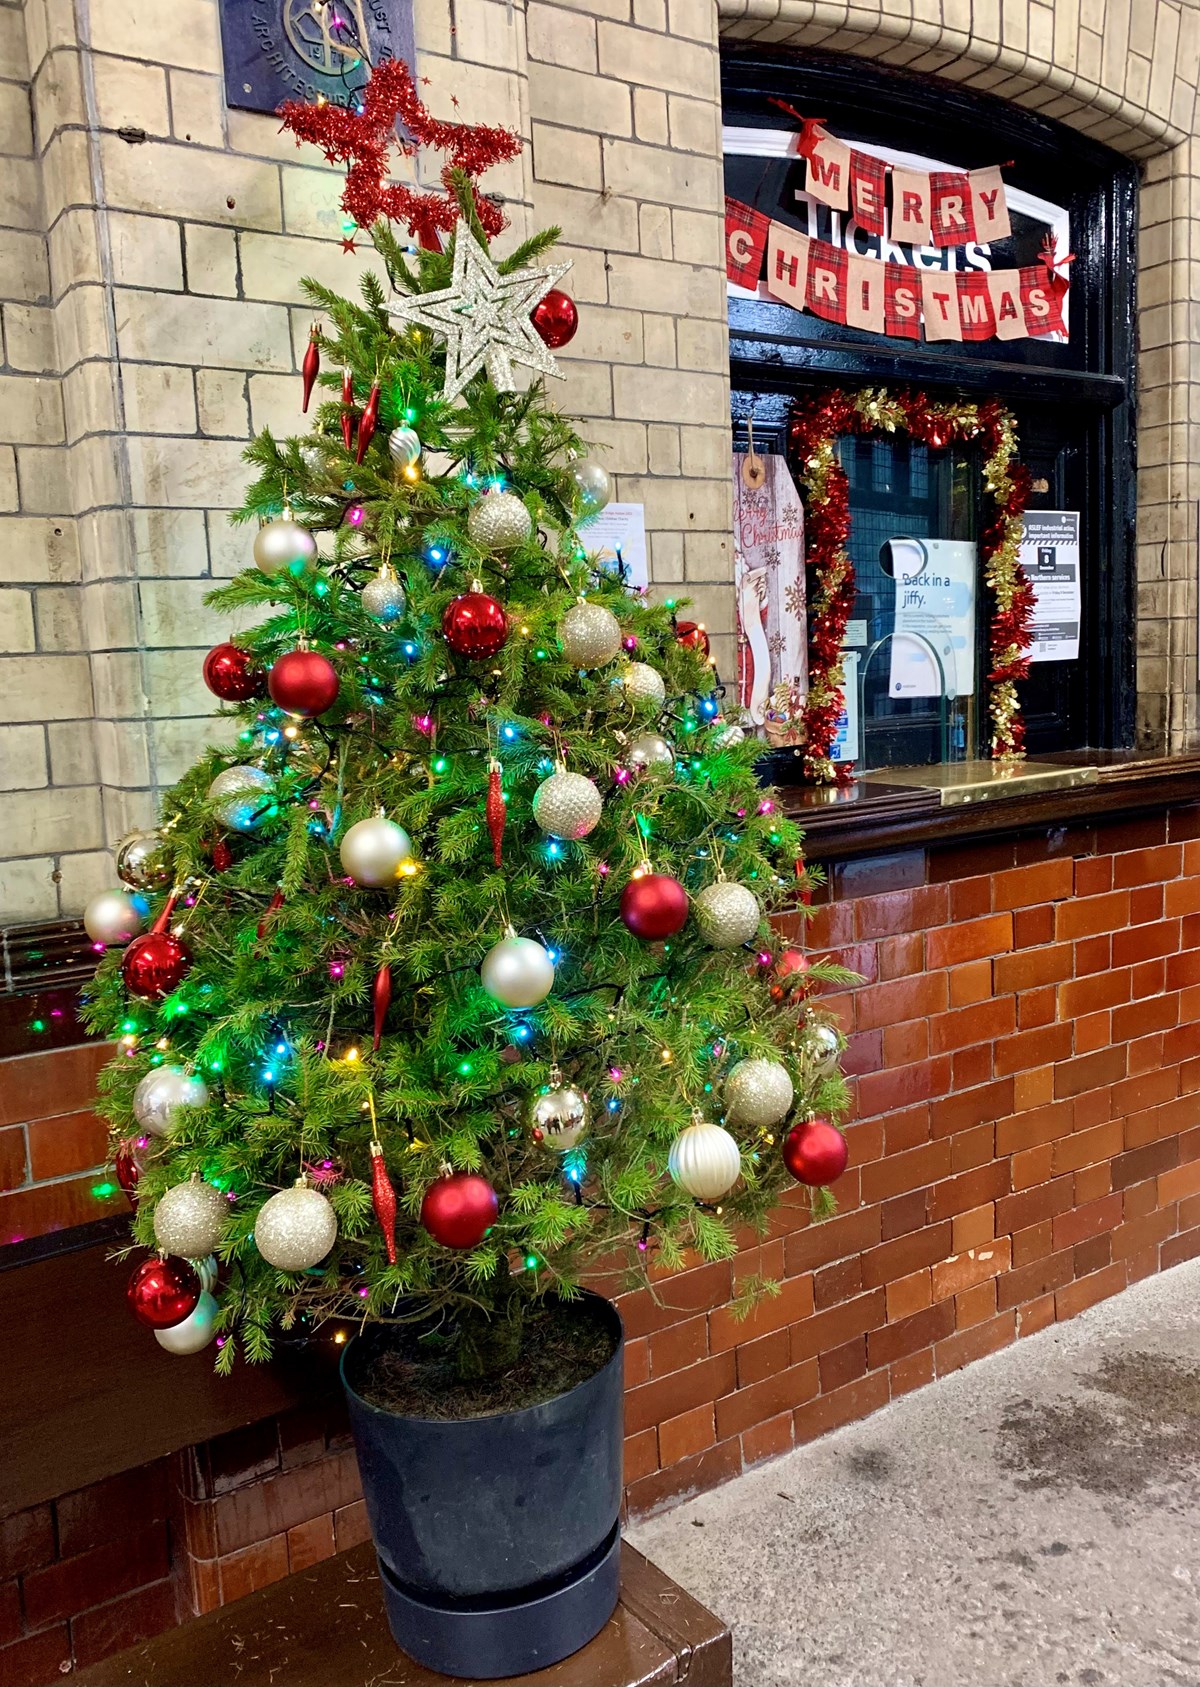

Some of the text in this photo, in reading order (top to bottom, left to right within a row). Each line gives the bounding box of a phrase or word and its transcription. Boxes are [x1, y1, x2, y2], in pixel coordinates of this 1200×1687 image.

[251, 14, 365, 111] ARCHITECTURA
[815, 153, 999, 227] MERRY
[729, 229, 1050, 323] CHRISTMAS
[741, 523, 804, 549] Christmas
[1043, 554, 1050, 564] 8
[902, 572, 950, 587] Back in a
[902, 590, 926, 609] jiffy.
